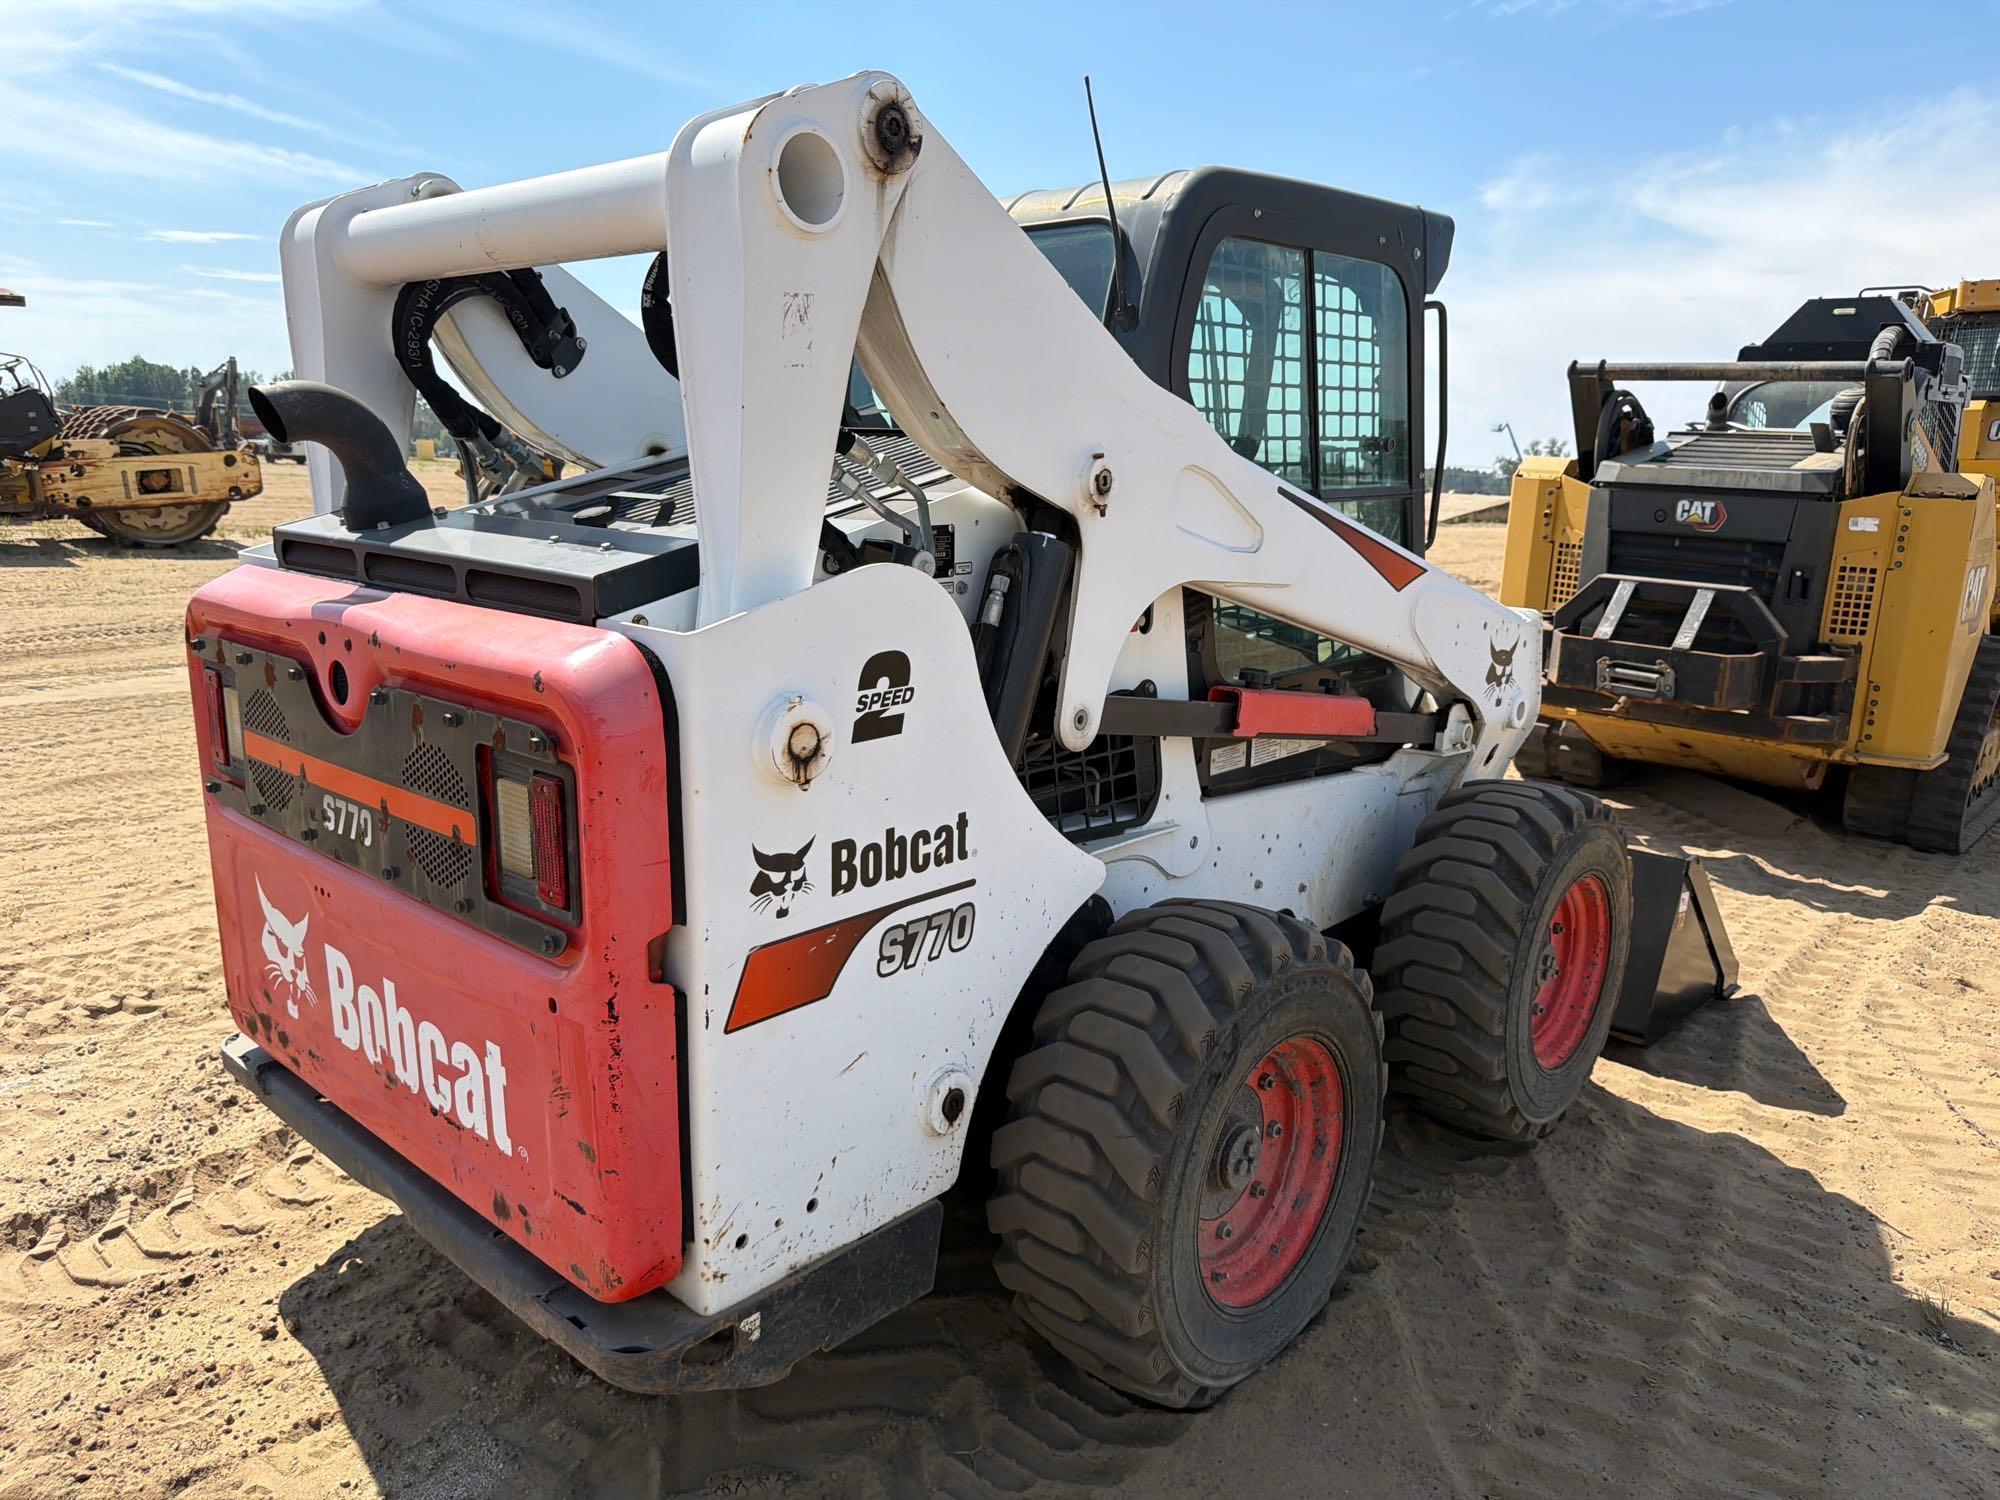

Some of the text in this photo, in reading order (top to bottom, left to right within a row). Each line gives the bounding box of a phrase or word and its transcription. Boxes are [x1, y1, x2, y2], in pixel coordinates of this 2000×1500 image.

[1676, 500, 1715, 524] CAT
[1962, 566, 1987, 621] CAT
[851, 650, 911, 744] 2
[856, 686, 915, 713] SPEED
[323, 794, 372, 846] S770
[832, 811, 968, 897] Bobcat
[877, 902, 976, 978] S770
[324, 943, 512, 1156] Bobcat
